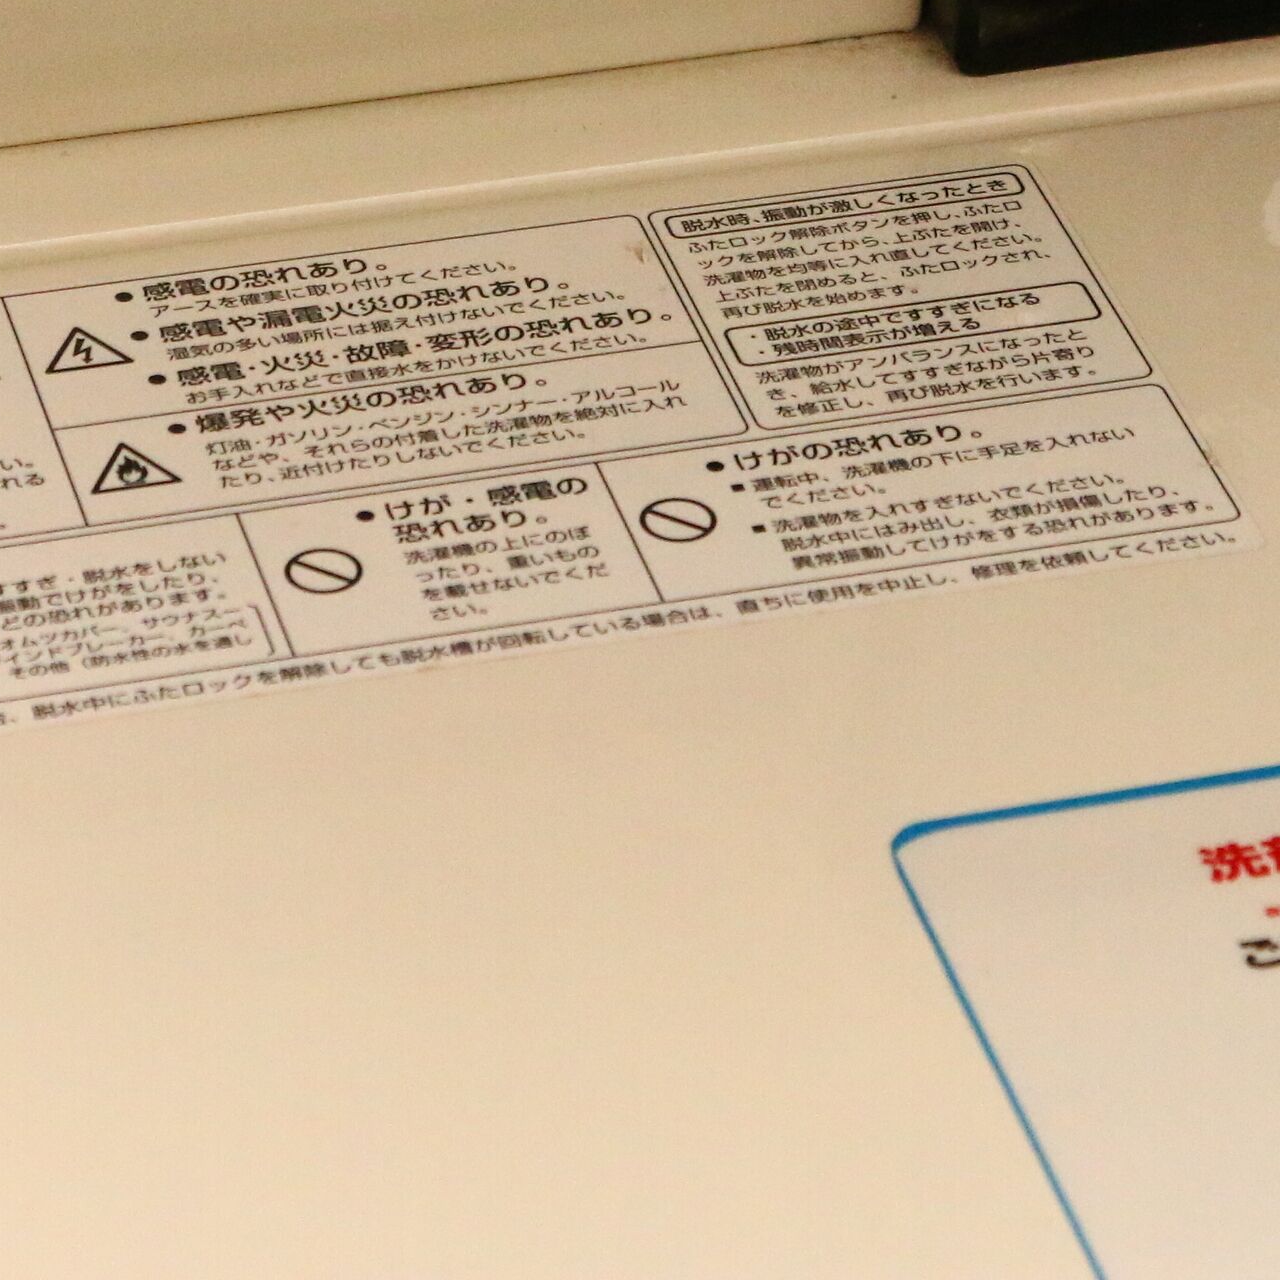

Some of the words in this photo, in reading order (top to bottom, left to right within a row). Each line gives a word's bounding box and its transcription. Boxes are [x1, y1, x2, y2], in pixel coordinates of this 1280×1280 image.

[140, 257, 389, 303] 感電の恐れあり。
[157, 276, 570, 344] 感電や漏電火災の恐れあり。
[193, 372, 548, 435] 爆発や火災の恐れあり。
[731, 423, 984, 472] けがの恐れあり。
[759, 482, 887, 510] でください。
[390, 508, 549, 545] 恐れあり。
[429, 603, 489, 622] さい。
